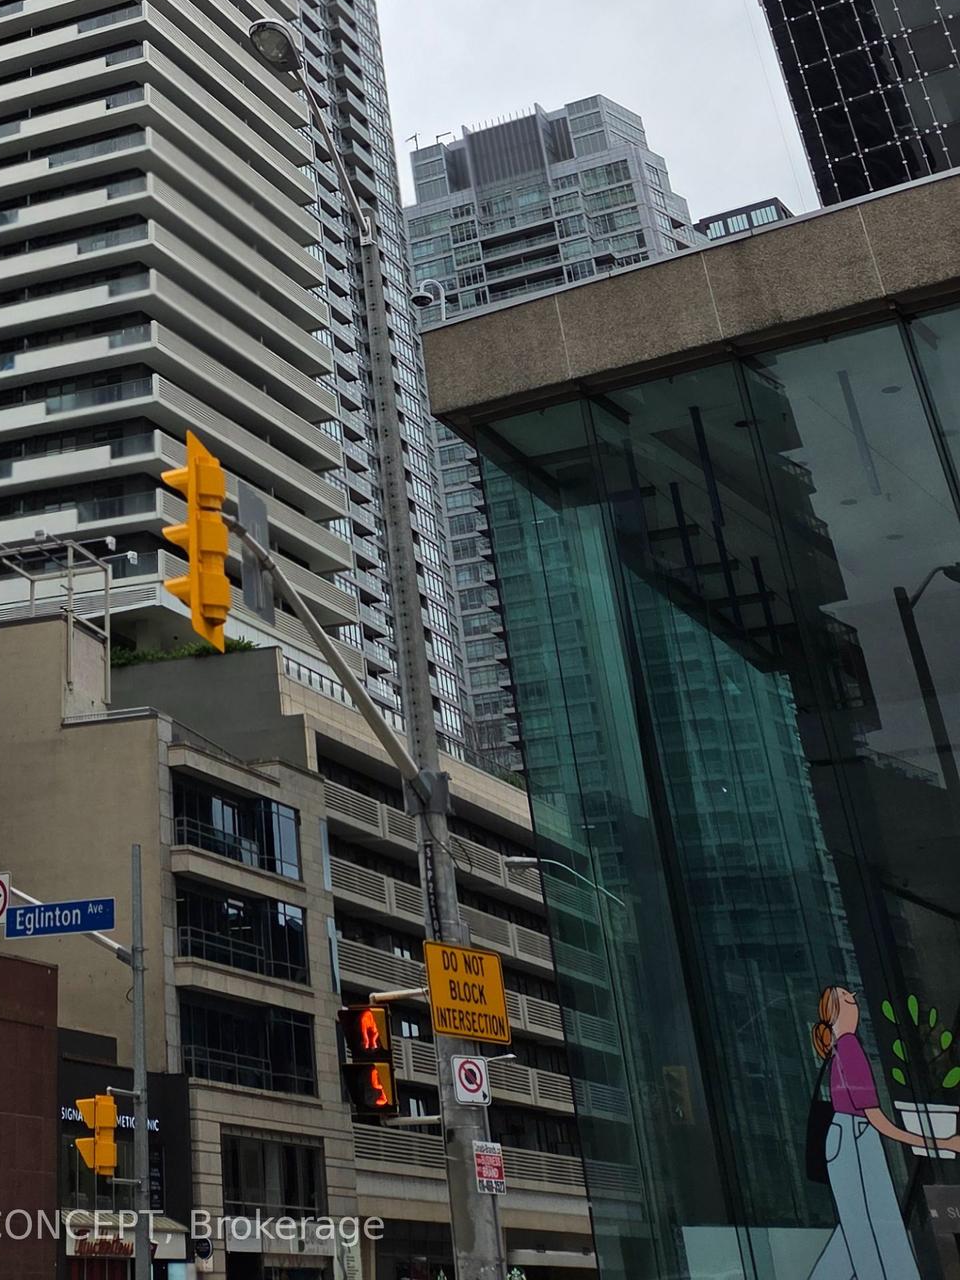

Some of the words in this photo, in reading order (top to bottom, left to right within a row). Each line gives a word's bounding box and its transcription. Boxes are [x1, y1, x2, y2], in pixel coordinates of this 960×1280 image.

[16, 907, 81, 935] Eglinton
[88, 903, 104, 915] Ave
[441, 950, 458, 972] DO
[462, 953, 485, 977] NOT
[449, 979, 487, 1005] BLOCK
[436, 1006, 506, 1037] INTERSECTION
[61, 1107, 83, 1121] SIGNA
